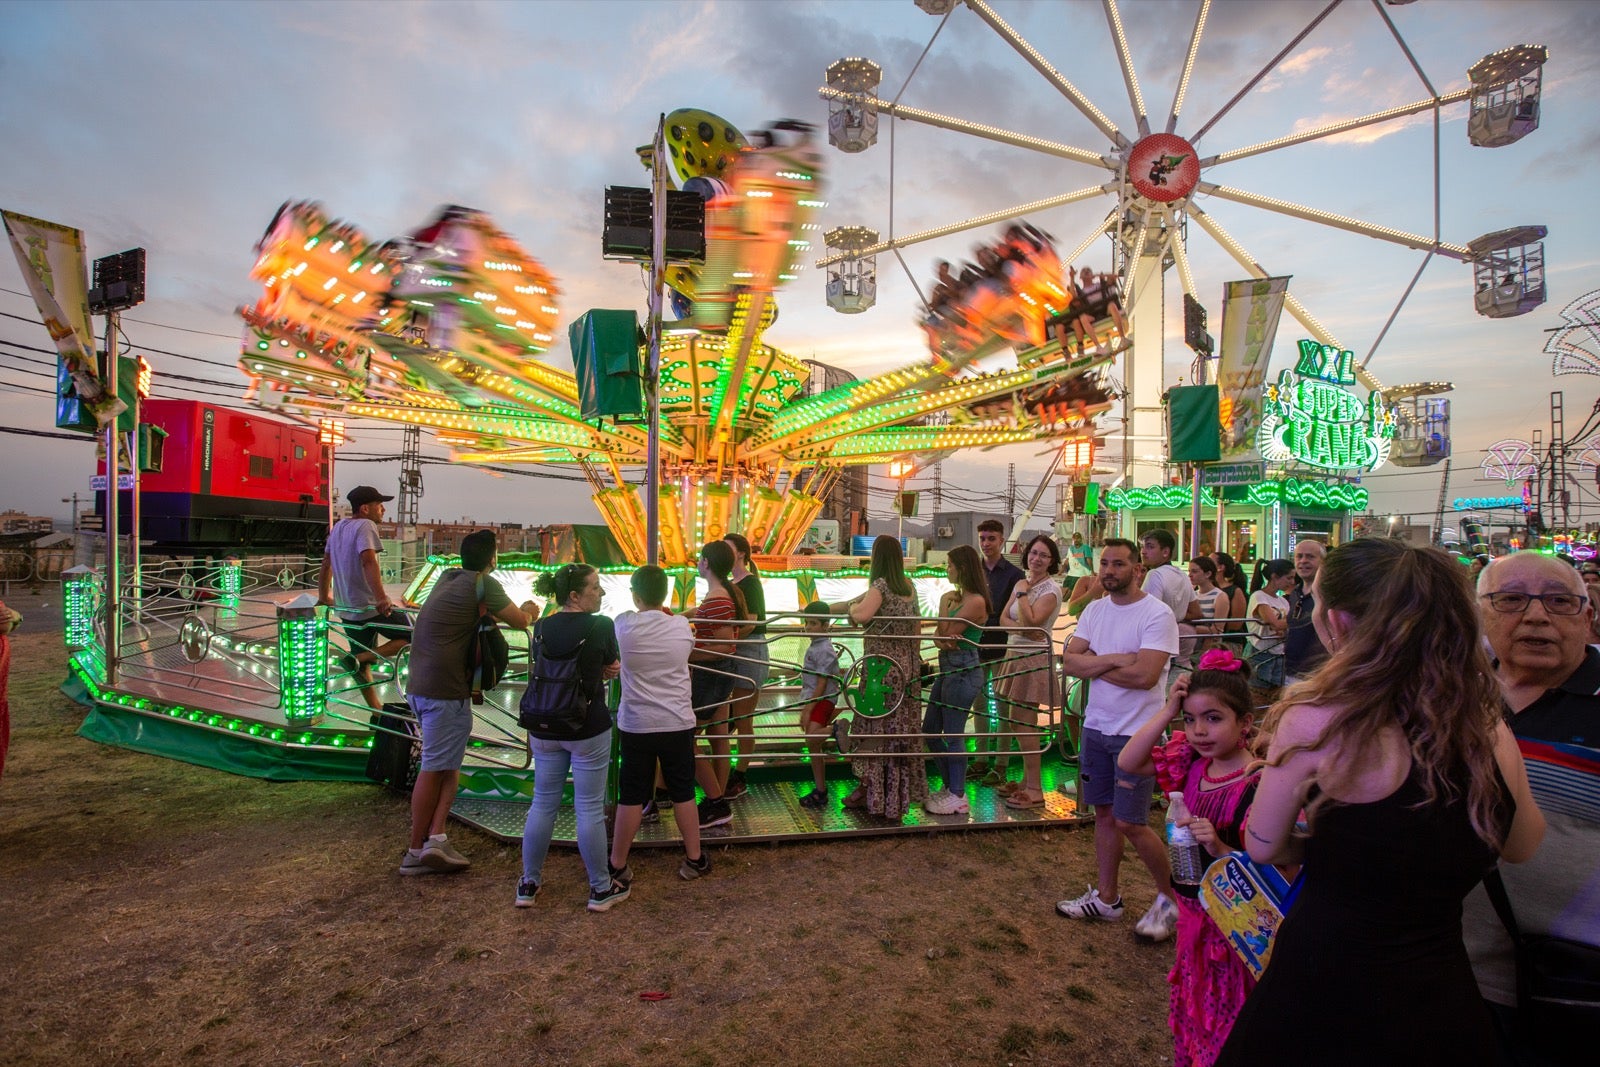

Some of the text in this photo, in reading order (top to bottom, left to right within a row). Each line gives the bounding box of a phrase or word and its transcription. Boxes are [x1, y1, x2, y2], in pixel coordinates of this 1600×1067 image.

[1295, 339, 1356, 386] XXL
[1300, 379, 1363, 422] SUPER
[1289, 408, 1371, 467] RANA
[1213, 874, 1244, 907] Max
[1228, 861, 1253, 898] PULEVA
